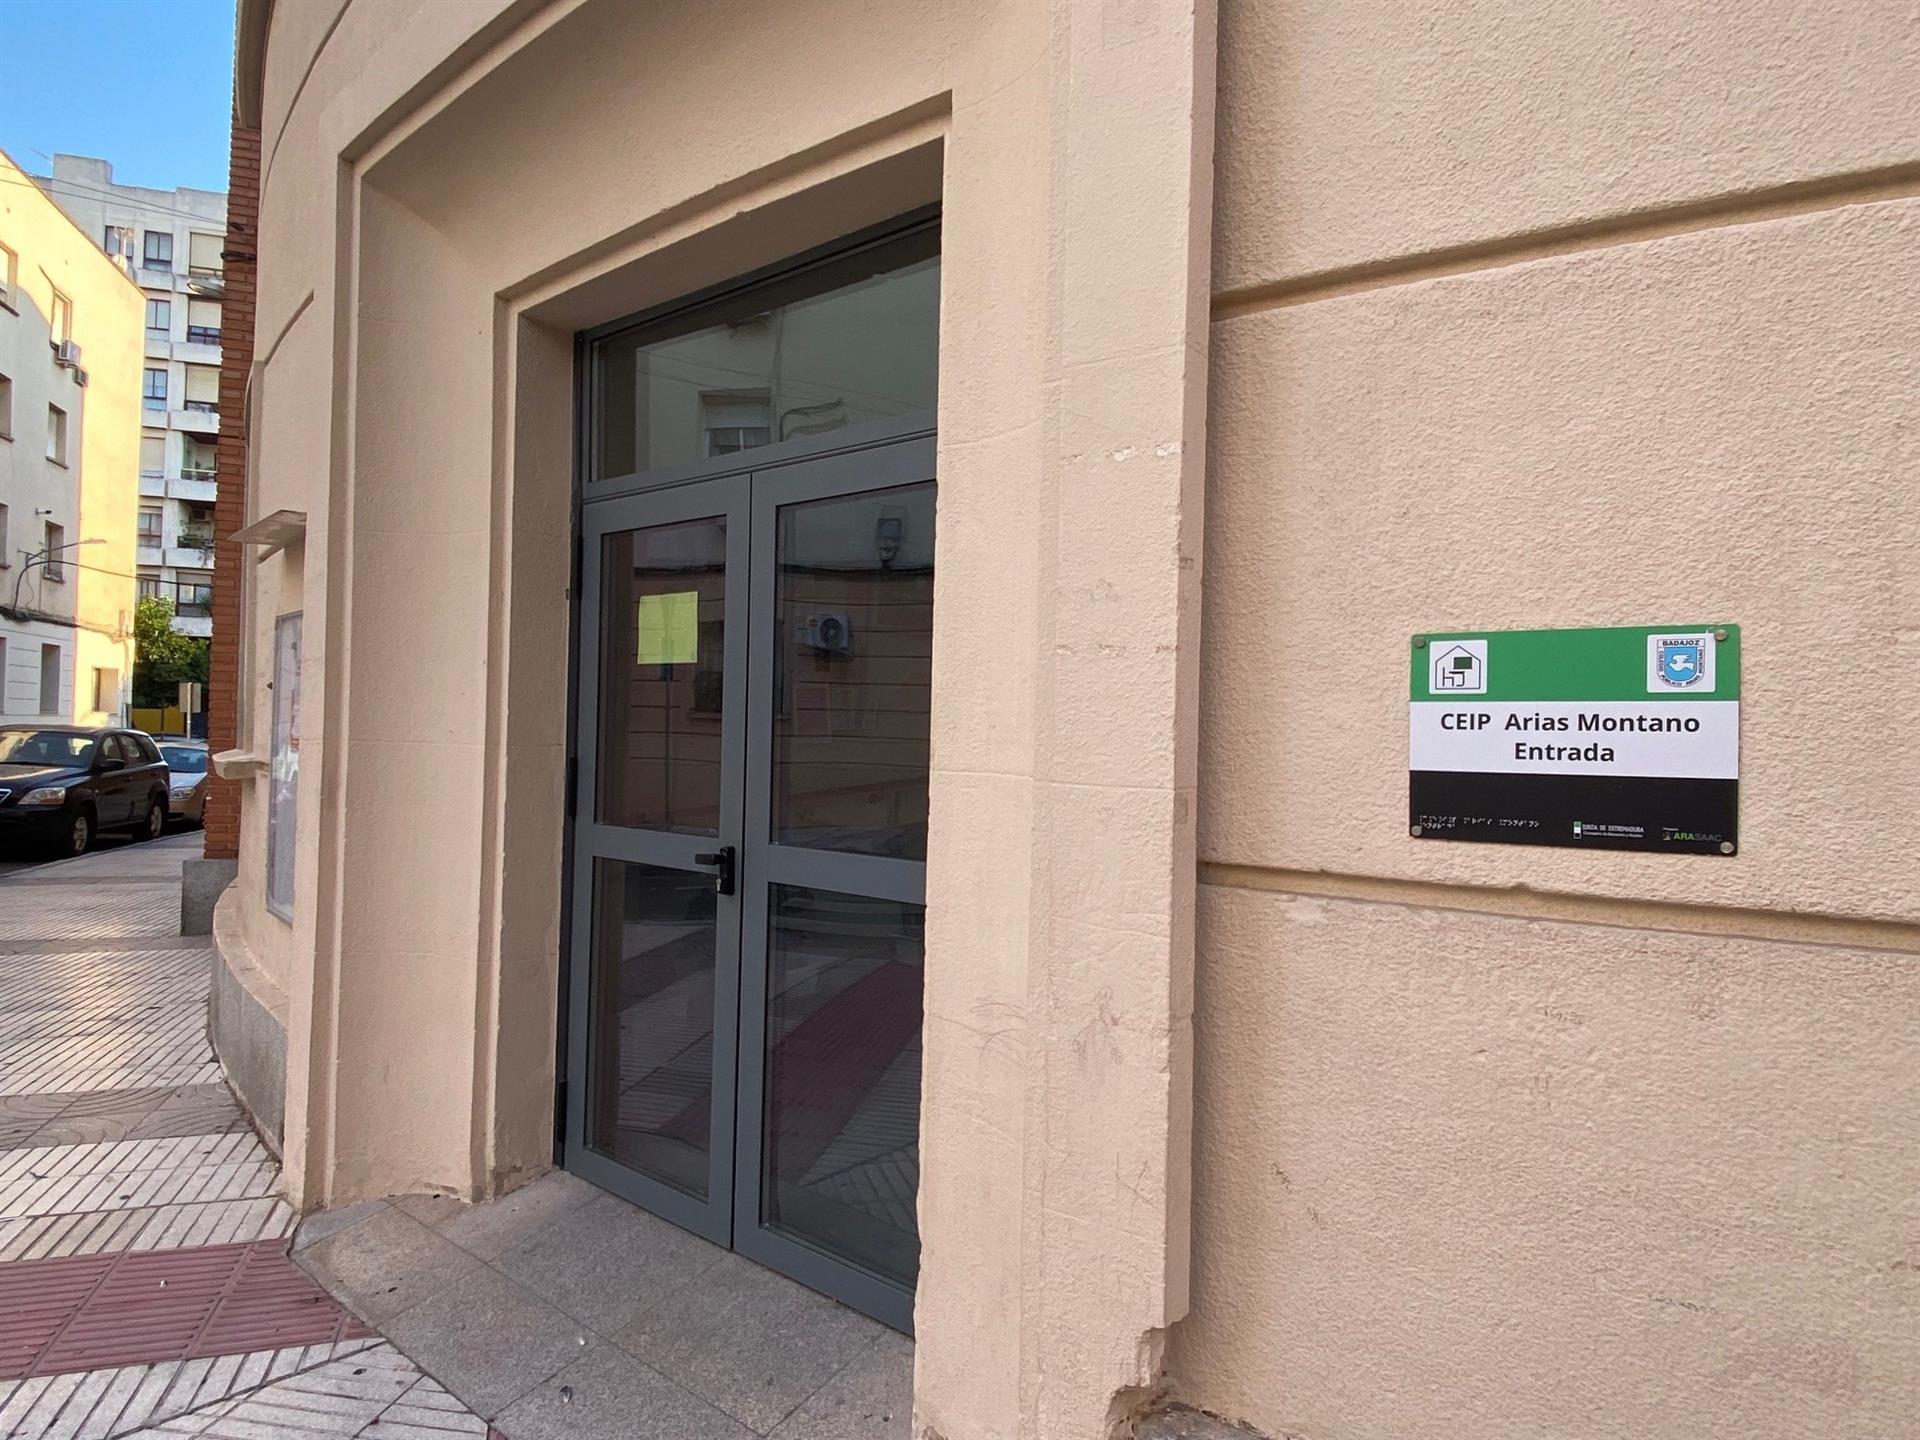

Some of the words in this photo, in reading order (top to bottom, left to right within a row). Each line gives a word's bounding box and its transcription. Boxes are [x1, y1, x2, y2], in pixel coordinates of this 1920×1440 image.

[1440, 713, 1491, 730] CEIP
[1504, 713, 1569, 731] Arias
[1577, 713, 1701, 732] Montano
[1514, 742, 1615, 762] Entrada
[1673, 832, 1722, 841] ARASAAC
